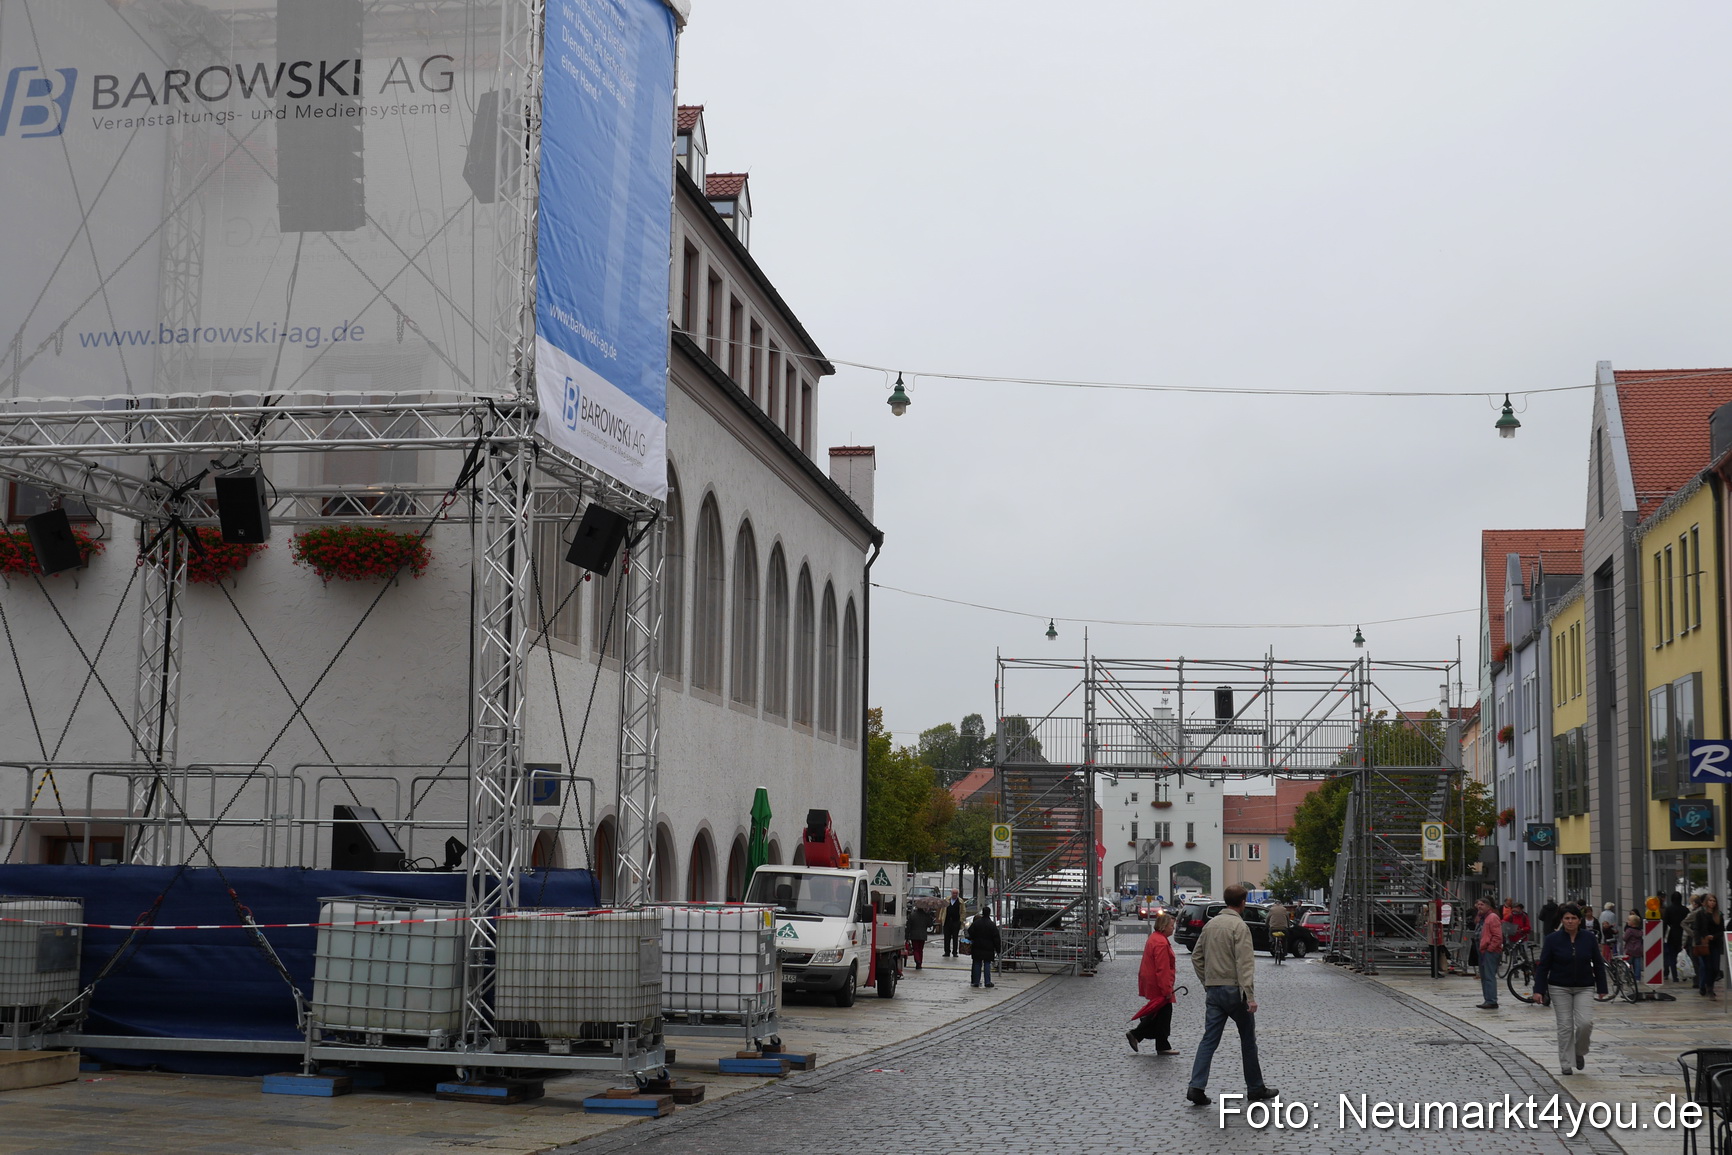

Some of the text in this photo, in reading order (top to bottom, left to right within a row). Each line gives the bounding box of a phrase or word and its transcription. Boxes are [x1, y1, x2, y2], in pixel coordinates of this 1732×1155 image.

[562, 3, 574, 23] wir
[575, 14, 593, 46] Ihnen
[594, 38, 603, 57] als
[92, 54, 455, 110] BAROWSKI AG
[561, 53, 579, 81] einer
[562, 24, 627, 108] Dienstleister alles aus
[92, 102, 451, 131] Veranstaltungs- und Mediensysteme
[78, 319, 366, 350] www.barowski-ag.de
[549, 303, 618, 361] www.barowski-ag.de
[581, 395, 646, 457] BAROWSKI AG
[1536, 830, 1547, 842] G2
[1686, 811, 1701, 828] G2
